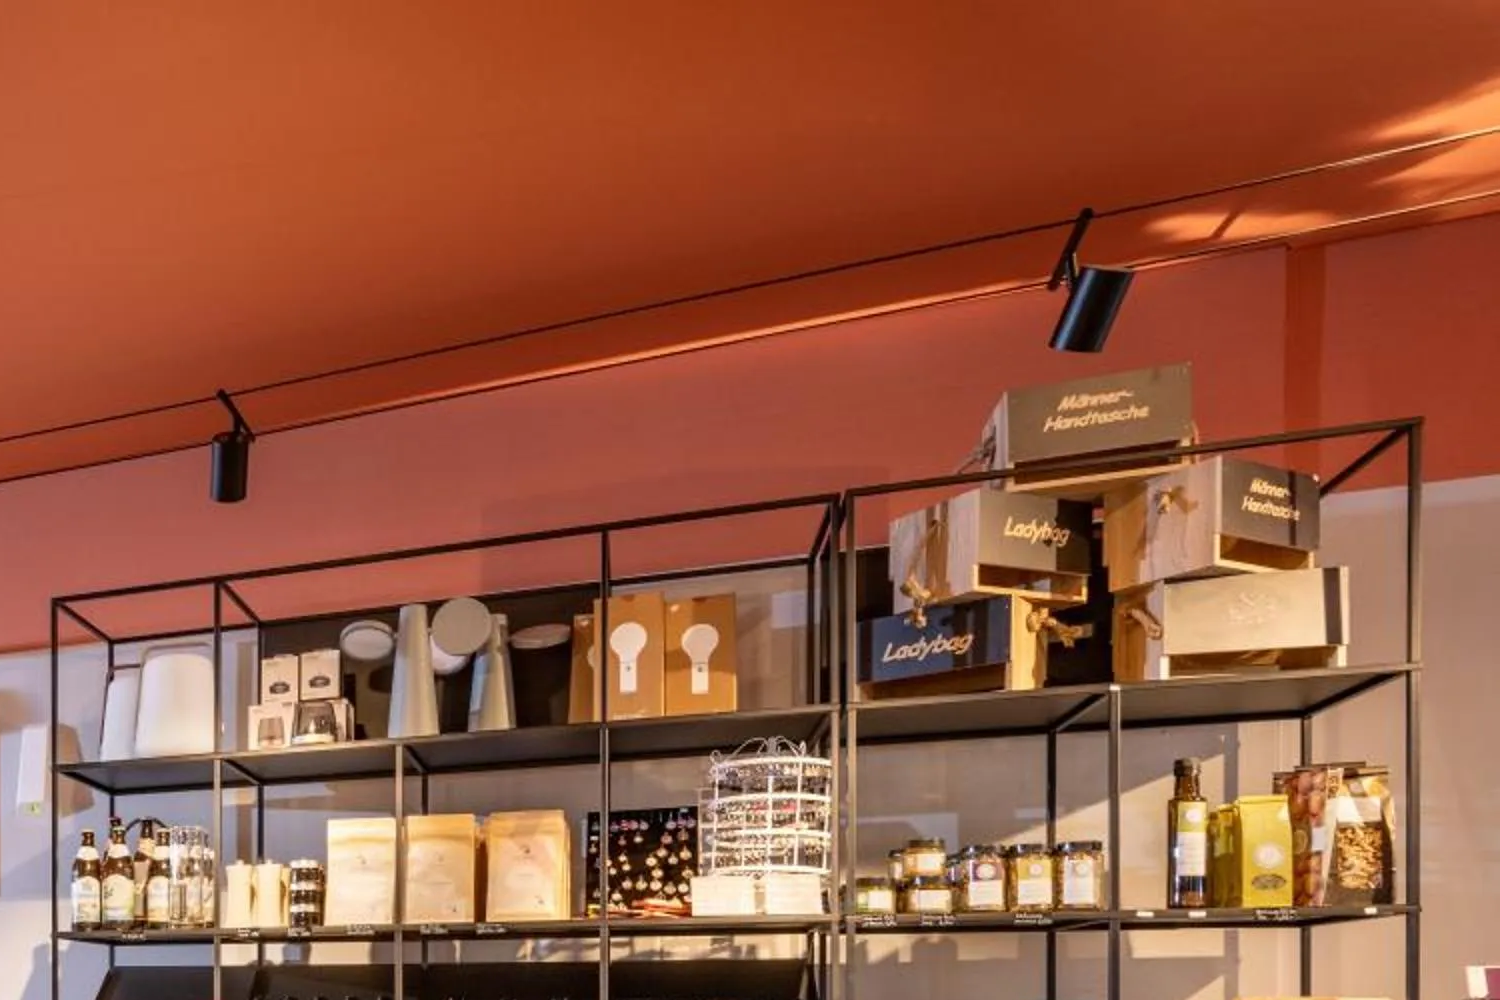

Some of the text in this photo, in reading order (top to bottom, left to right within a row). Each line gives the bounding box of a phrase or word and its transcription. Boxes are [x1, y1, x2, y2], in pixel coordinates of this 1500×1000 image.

[1043, 405, 1150, 432] Handtasche
[1003, 516, 1072, 547] Ladybag
[882, 631, 974, 662] Ladybag
